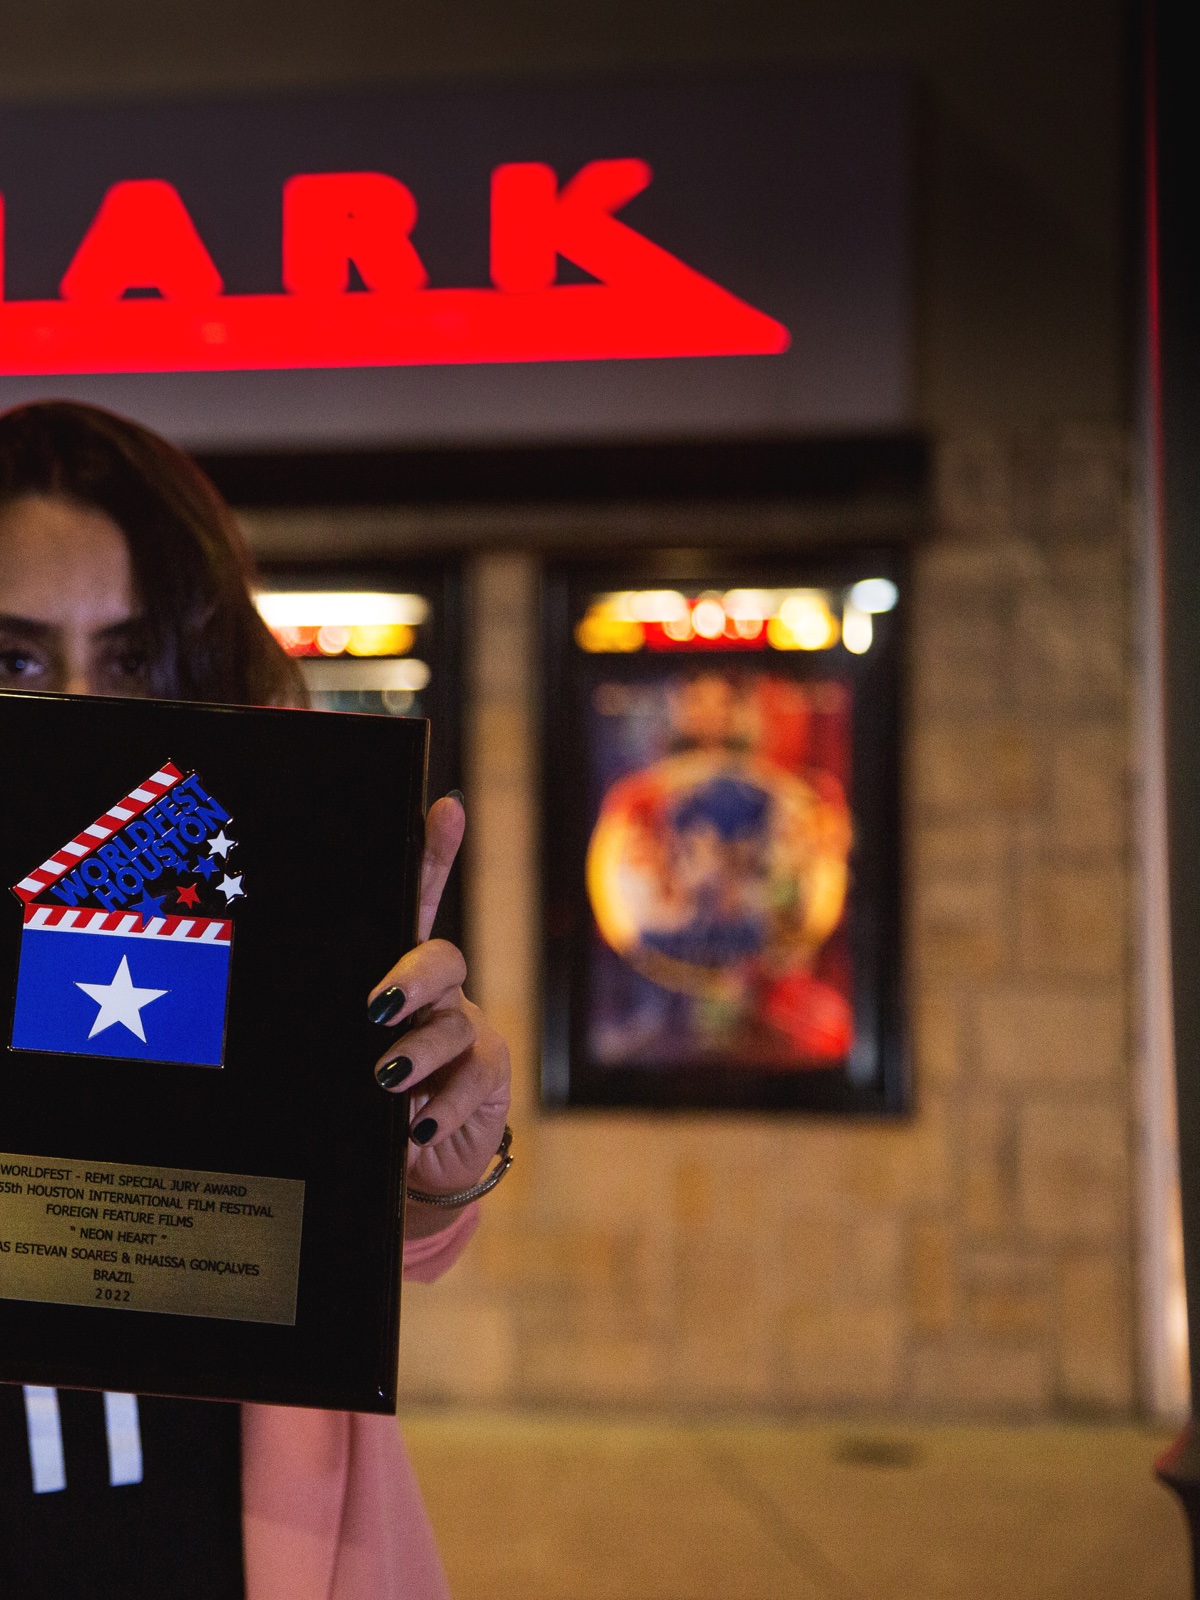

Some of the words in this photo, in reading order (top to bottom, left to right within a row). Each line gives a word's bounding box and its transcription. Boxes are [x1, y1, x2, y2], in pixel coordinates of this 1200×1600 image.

[50, 773, 211, 907] WORLDFEST
[92, 796, 231, 914] HOUSTON
[0, 1164, 72, 1181] WORLDFEST
[84, 1172, 115, 1185] REMI
[118, 1174, 167, 1190] SPECIAL
[170, 1180, 200, 1193] JURY
[203, 1183, 248, 1197] AWARD
[26, 1184, 85, 1200] HOUSTON
[88, 1189, 184, 1210] INTERNATIONAL
[187, 1199, 215, 1213] FILM
[219, 1201, 275, 1218] FESTIVAL
[45, 1203, 99, 1219] FOREIGN
[102, 1208, 155, 1225] FEATURE
[158, 1214, 194, 1228] FILMS
[80, 1227, 113, 1241] NEON
[117, 1231, 158, 1245] HEART
[15, 1242, 68, 1258] ESTEVAN
[71, 1247, 118, 1262] SOARES
[121, 1252, 130, 1264] &
[135, 1253, 186, 1270] RHAISSA
[189, 1258, 260, 1277] GONÇALVES
[93, 1268, 135, 1284] BRAZIL
[95, 1287, 131, 1302] 2022
